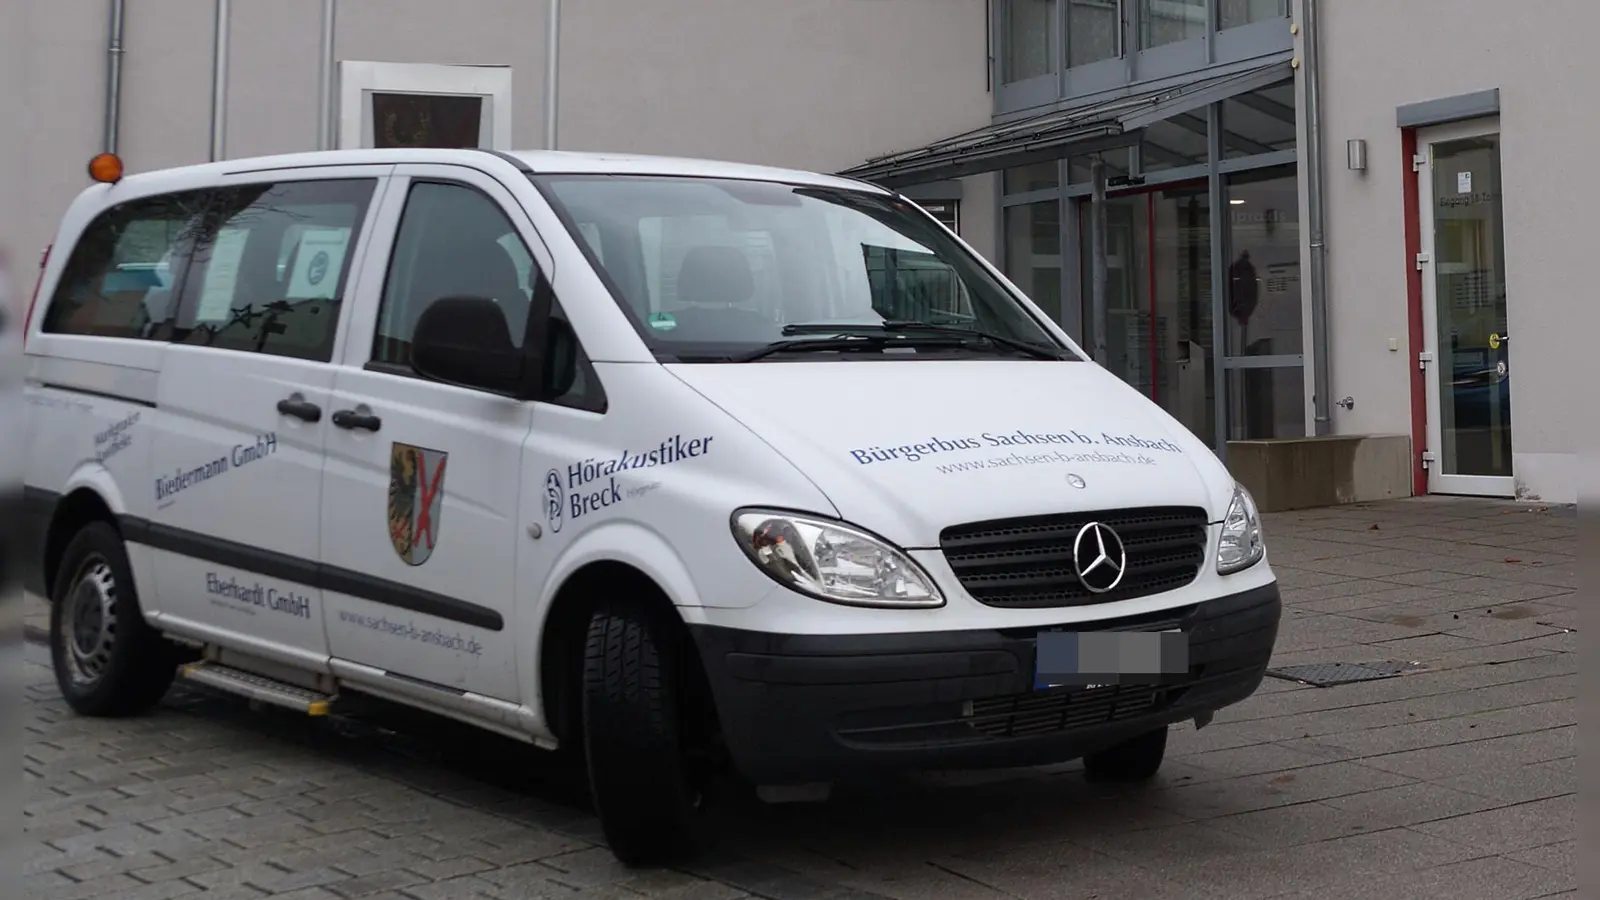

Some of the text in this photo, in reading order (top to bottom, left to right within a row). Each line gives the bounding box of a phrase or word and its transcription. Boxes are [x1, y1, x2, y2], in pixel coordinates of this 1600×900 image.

[155, 432, 277, 500] Biedermann GmbH
[567, 434, 714, 489] Hörakustiker
[850, 429, 1182, 465] Bürgerbus Sachsen b. Ansbach
[935, 450, 1157, 475] www.sachsen-b-ansbach.de
[570, 476, 622, 519] Breck
[267, 588, 311, 620] GmbH
